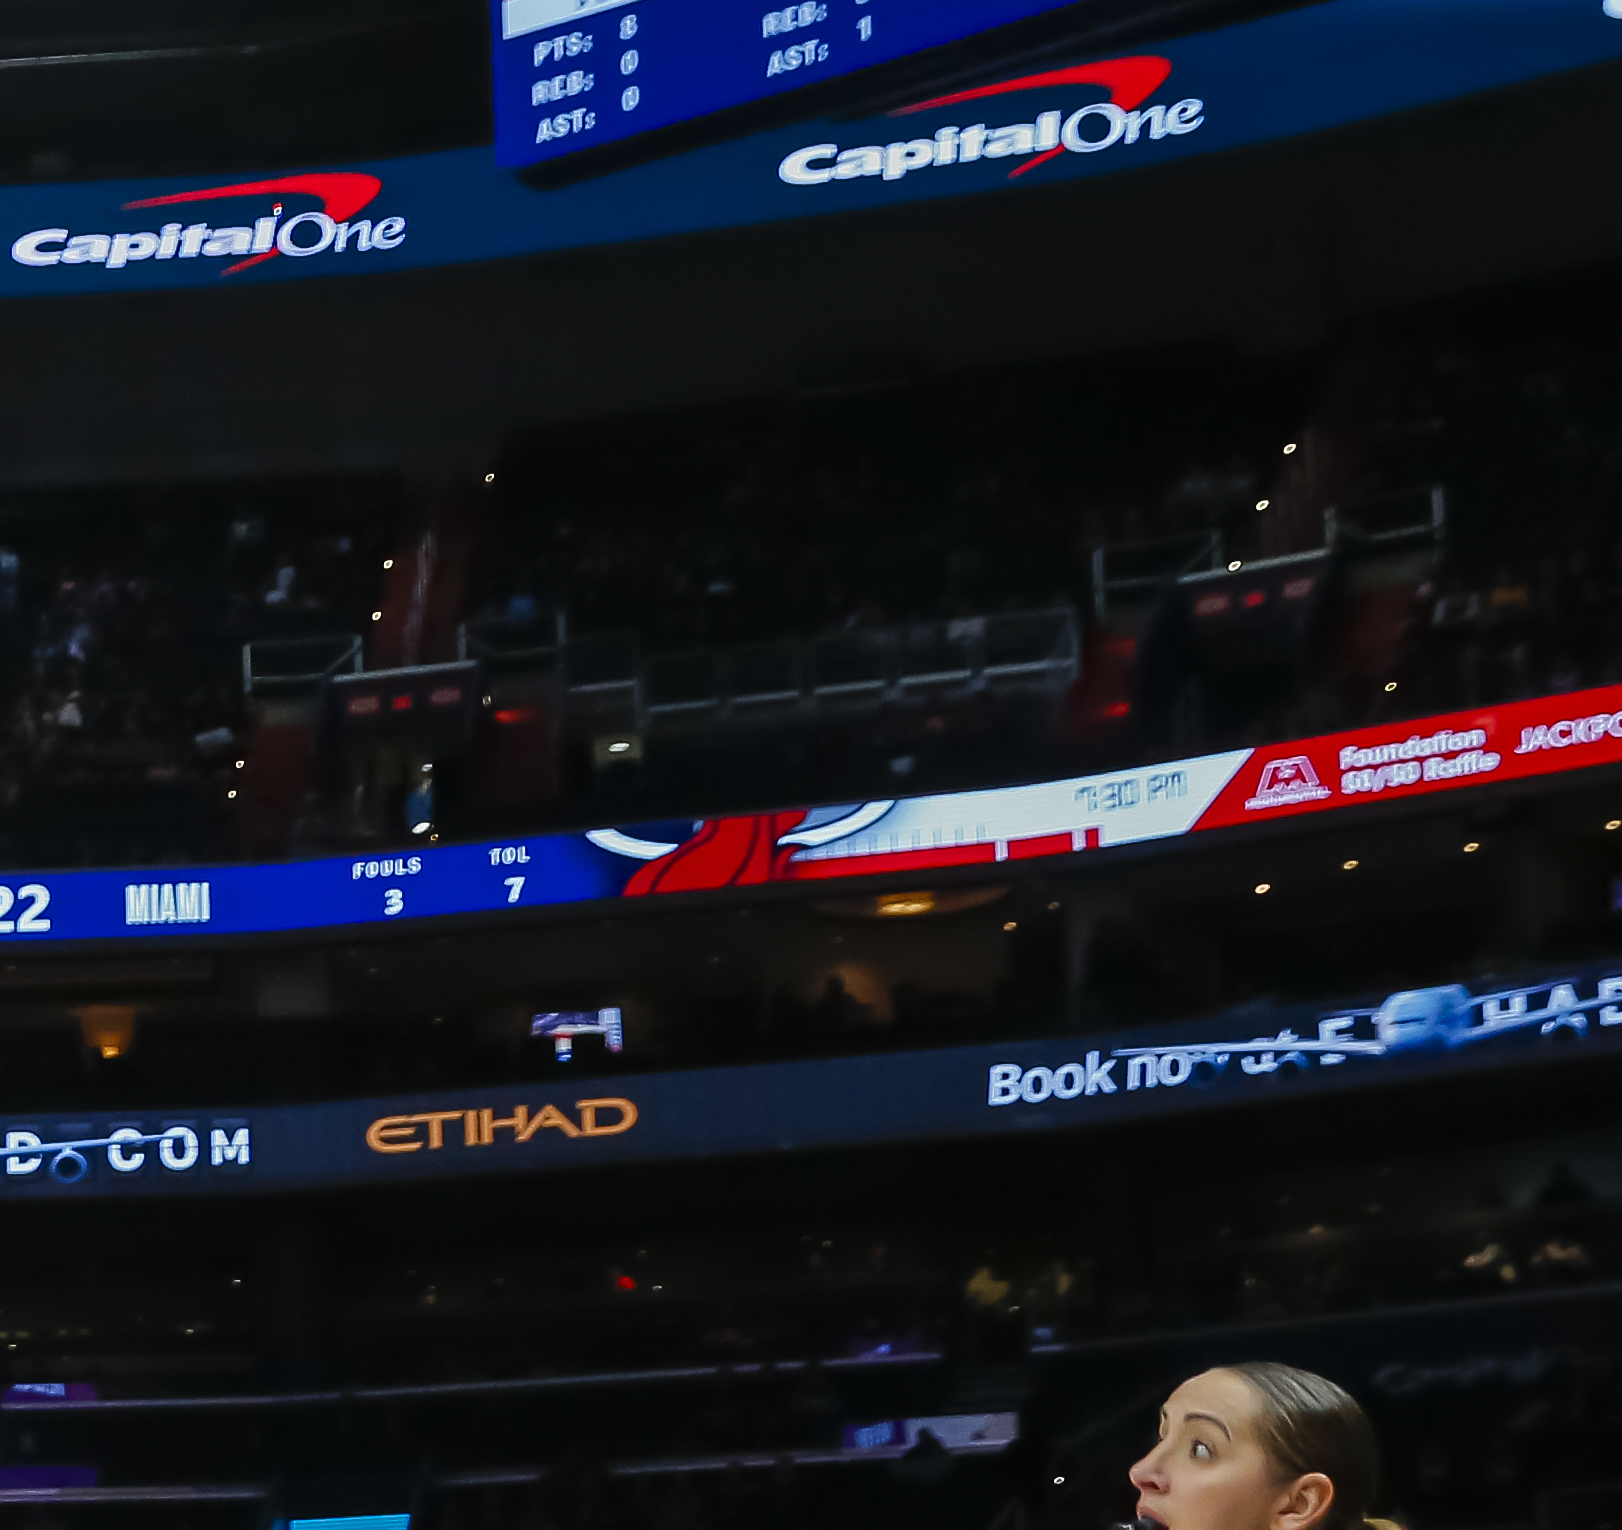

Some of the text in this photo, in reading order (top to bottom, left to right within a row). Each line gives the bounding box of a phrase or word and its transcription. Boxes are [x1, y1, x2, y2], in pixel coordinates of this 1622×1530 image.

[533, 31, 594, 67] PTS:
[766, 39, 829, 77] AST:
[535, 107, 596, 143] AST:
[351, 854, 422, 880] FOULS
[488, 844, 531, 867] TOL
[124, 880, 211, 926] MIAMI
[382, 888, 405, 916] 3
[503, 875, 527, 905] 7
[987, 1050, 1118, 1107] Book
[364, 1096, 639, 1154] ETIHAD
